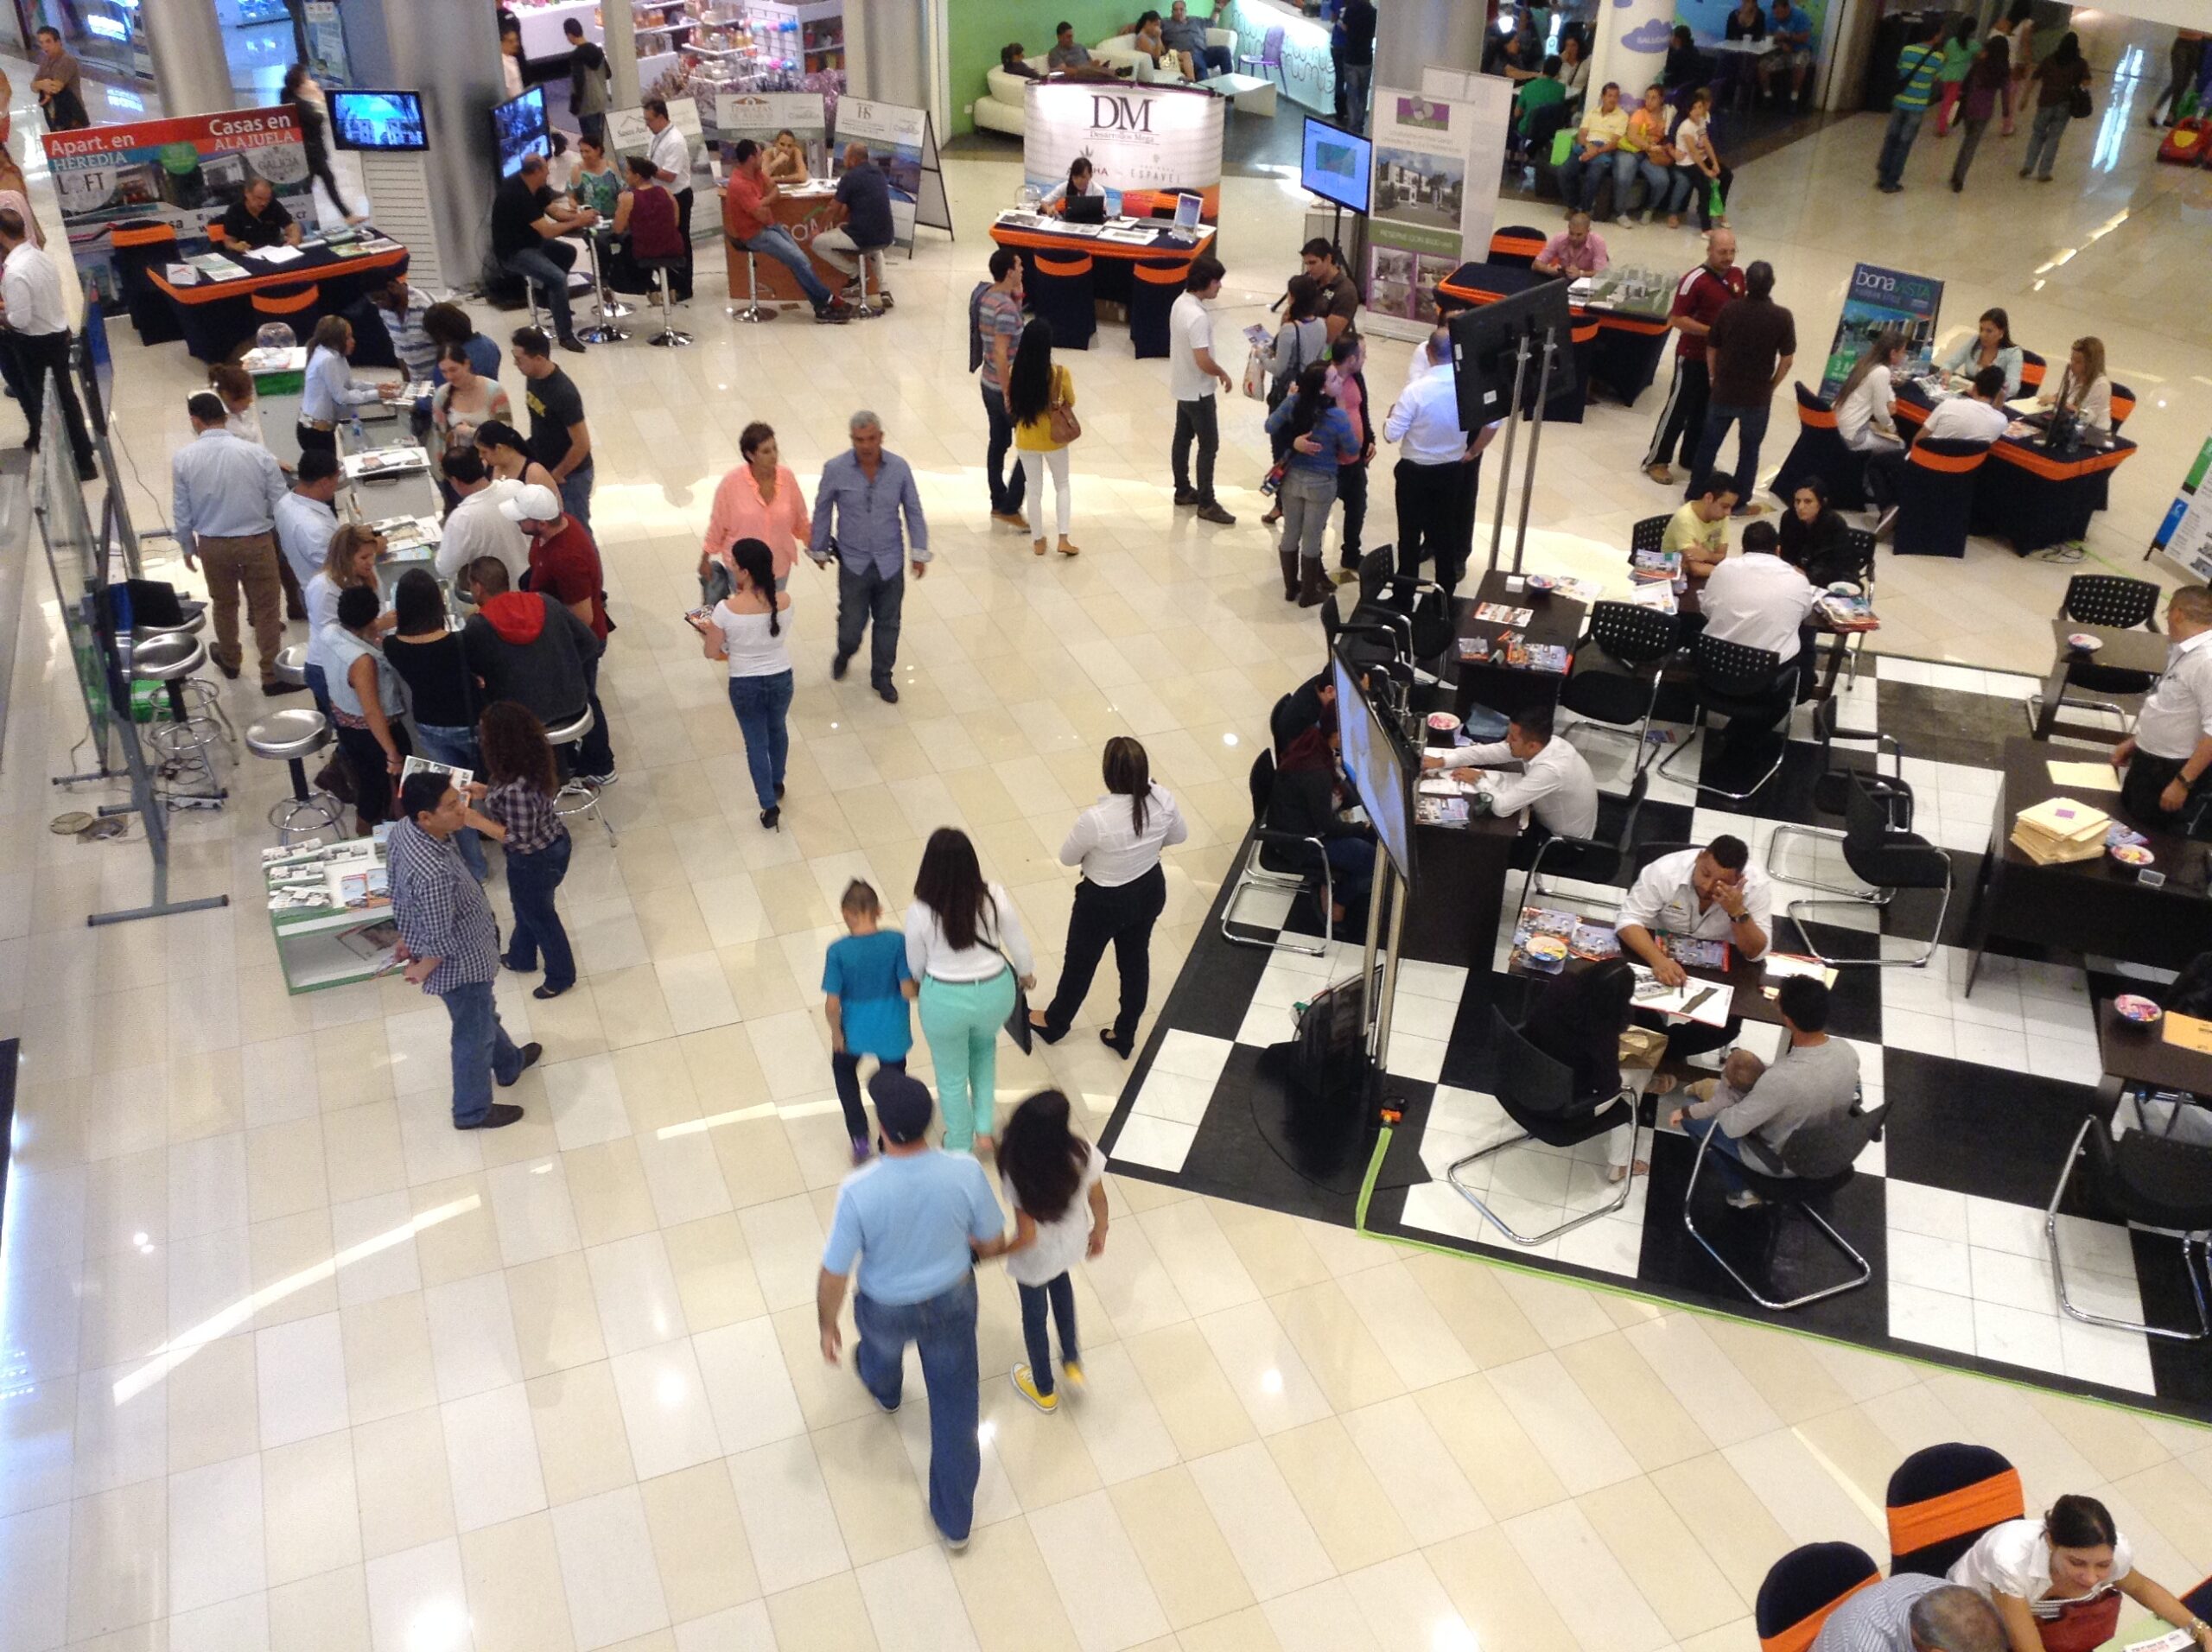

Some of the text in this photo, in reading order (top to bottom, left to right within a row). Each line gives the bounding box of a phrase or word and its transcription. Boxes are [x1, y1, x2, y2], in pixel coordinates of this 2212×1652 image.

[1090, 94, 1154, 132] DM
[209, 113, 291, 137] Casas en
[51, 133, 135, 157] Apart. en
[214, 131, 295, 151] ALAJUELA
[1090, 130, 1155, 144] Desarrollos Mega
[54, 150, 128, 172] HEREDIA
